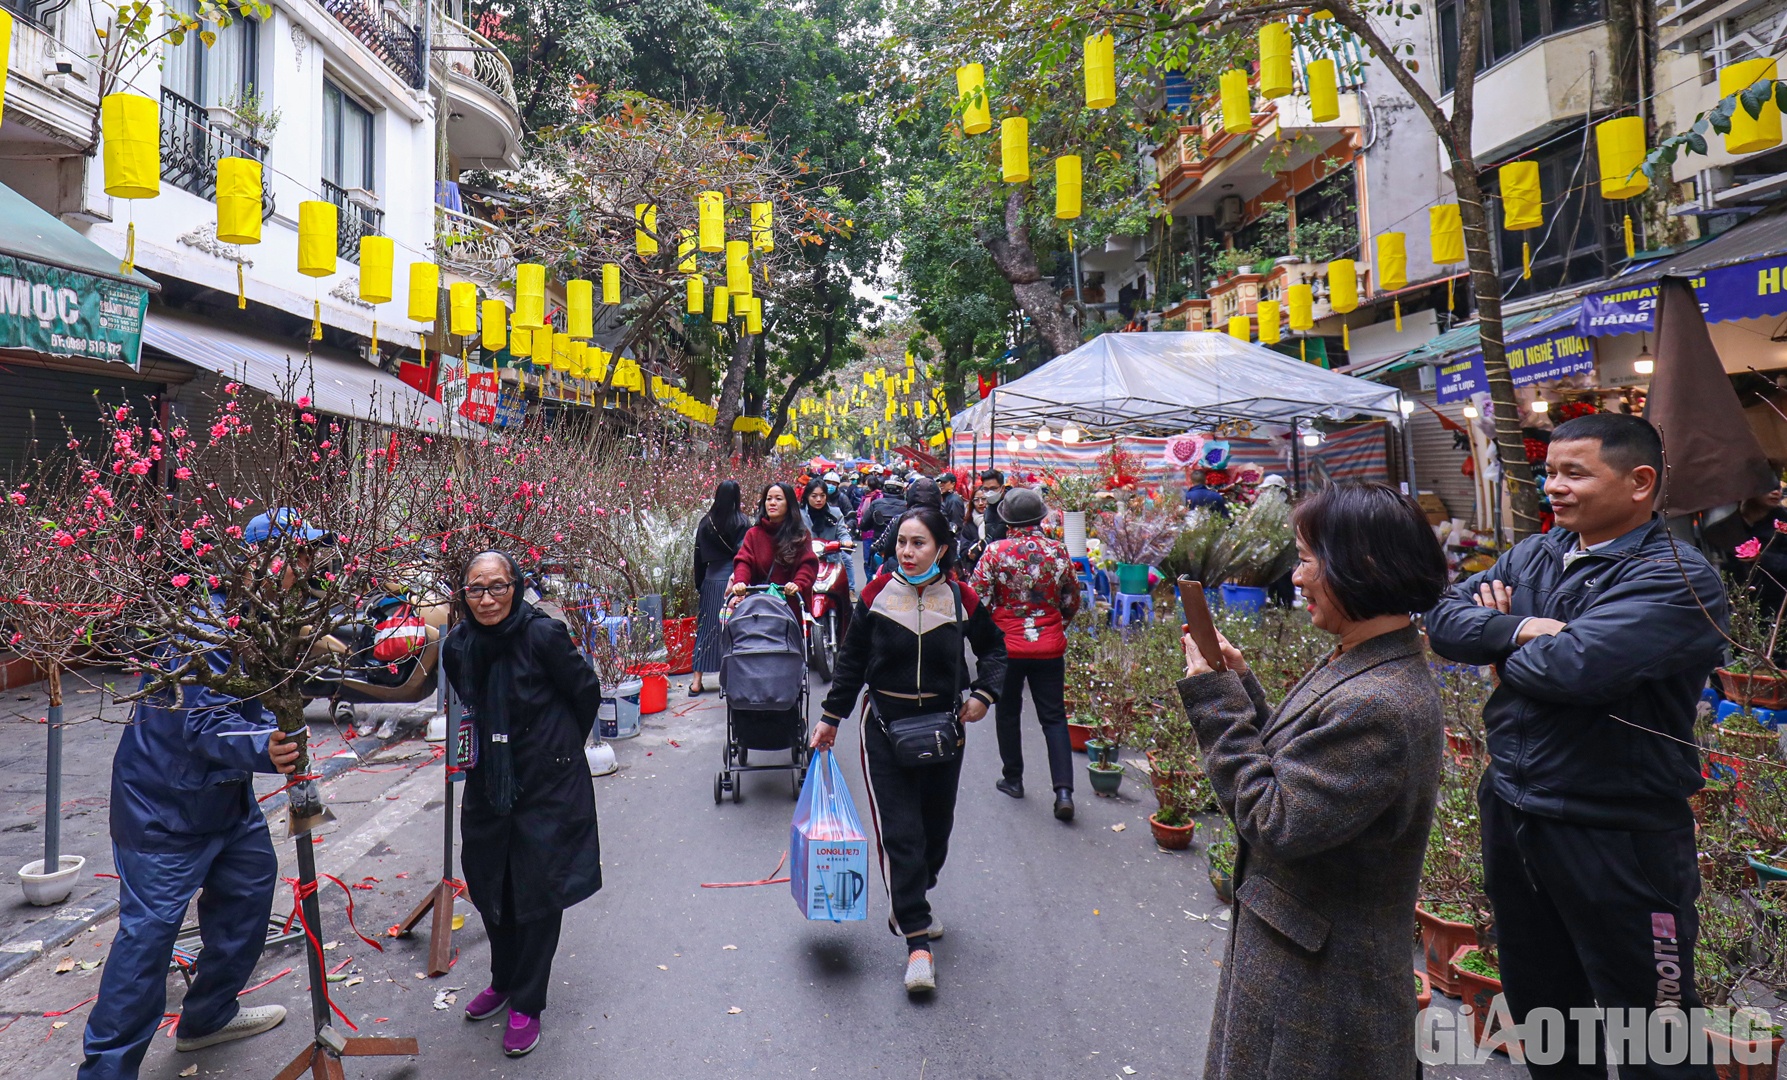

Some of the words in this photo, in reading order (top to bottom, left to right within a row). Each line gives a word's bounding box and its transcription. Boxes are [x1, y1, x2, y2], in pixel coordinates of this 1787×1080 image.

[1602, 277, 1706, 305] HIMARI
[1758, 266, 1787, 296] H
[1590, 312, 1650, 327] HÀNG
[1526, 338, 1554, 365] NGHỆ
[1441, 361, 1472, 376] HIMAWARI
[1442, 384, 1458, 395] HÀNG
